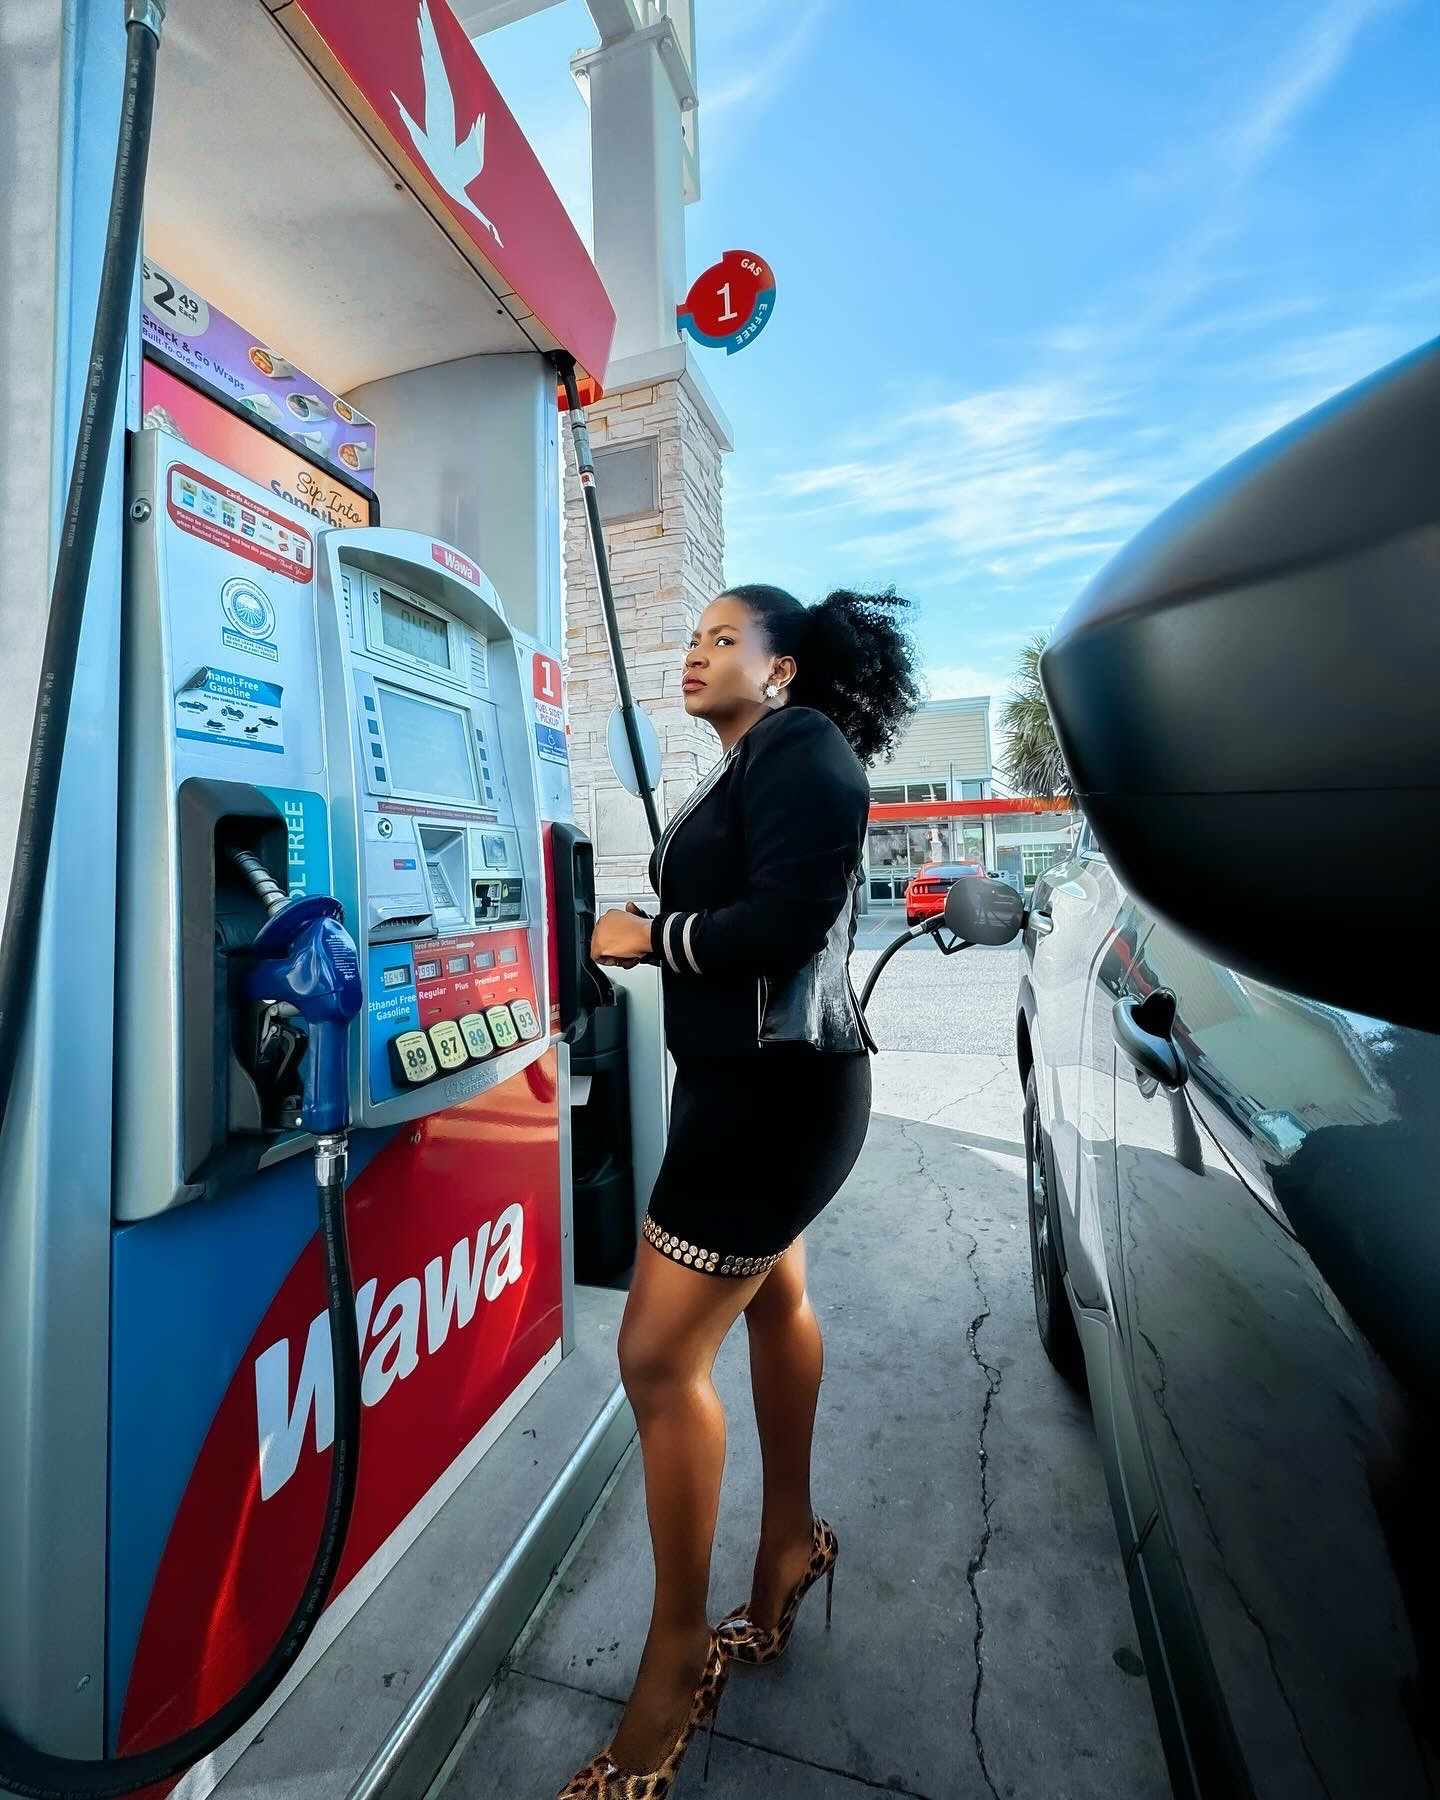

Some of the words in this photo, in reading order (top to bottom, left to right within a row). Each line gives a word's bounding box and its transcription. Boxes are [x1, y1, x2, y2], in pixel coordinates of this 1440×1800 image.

[740, 258, 762, 276] GAS
[178, 294, 199, 313] 49
[716, 282, 738, 322] 1
[178, 306, 197, 322] Each
[735, 303, 768, 345] E-FREE
[142, 314, 179, 345] Snack
[182, 341, 191, 354] &
[194, 350, 210, 365] Go
[213, 362, 245, 390] Wraps
[270, 480, 346, 528] Somethi
[296, 471, 327, 505] Sip
[325, 490, 362, 523] Into
[444, 551, 473, 580] Wawa
[541, 661, 555, 699] 1
[210, 681, 251, 699] Gasoline
[284, 801, 305, 865] FREE
[474, 975, 500, 987] Premium
[503, 971, 519, 980] Super
[418, 986, 447, 1000] Regular
[454, 981, 469, 992] Plus
[368, 997, 398, 1012] Ethanol
[399, 994, 417, 1005] Free
[376, 1006, 411, 1021] Gasoline
[518, 1011, 534, 1028] 93
[468, 1028, 485, 1046] 89
[495, 1021, 512, 1037] 91
[440, 1036, 459, 1057] 87
[406, 1047, 427, 1068] 89
[254, 1202, 525, 1502] Wawa
